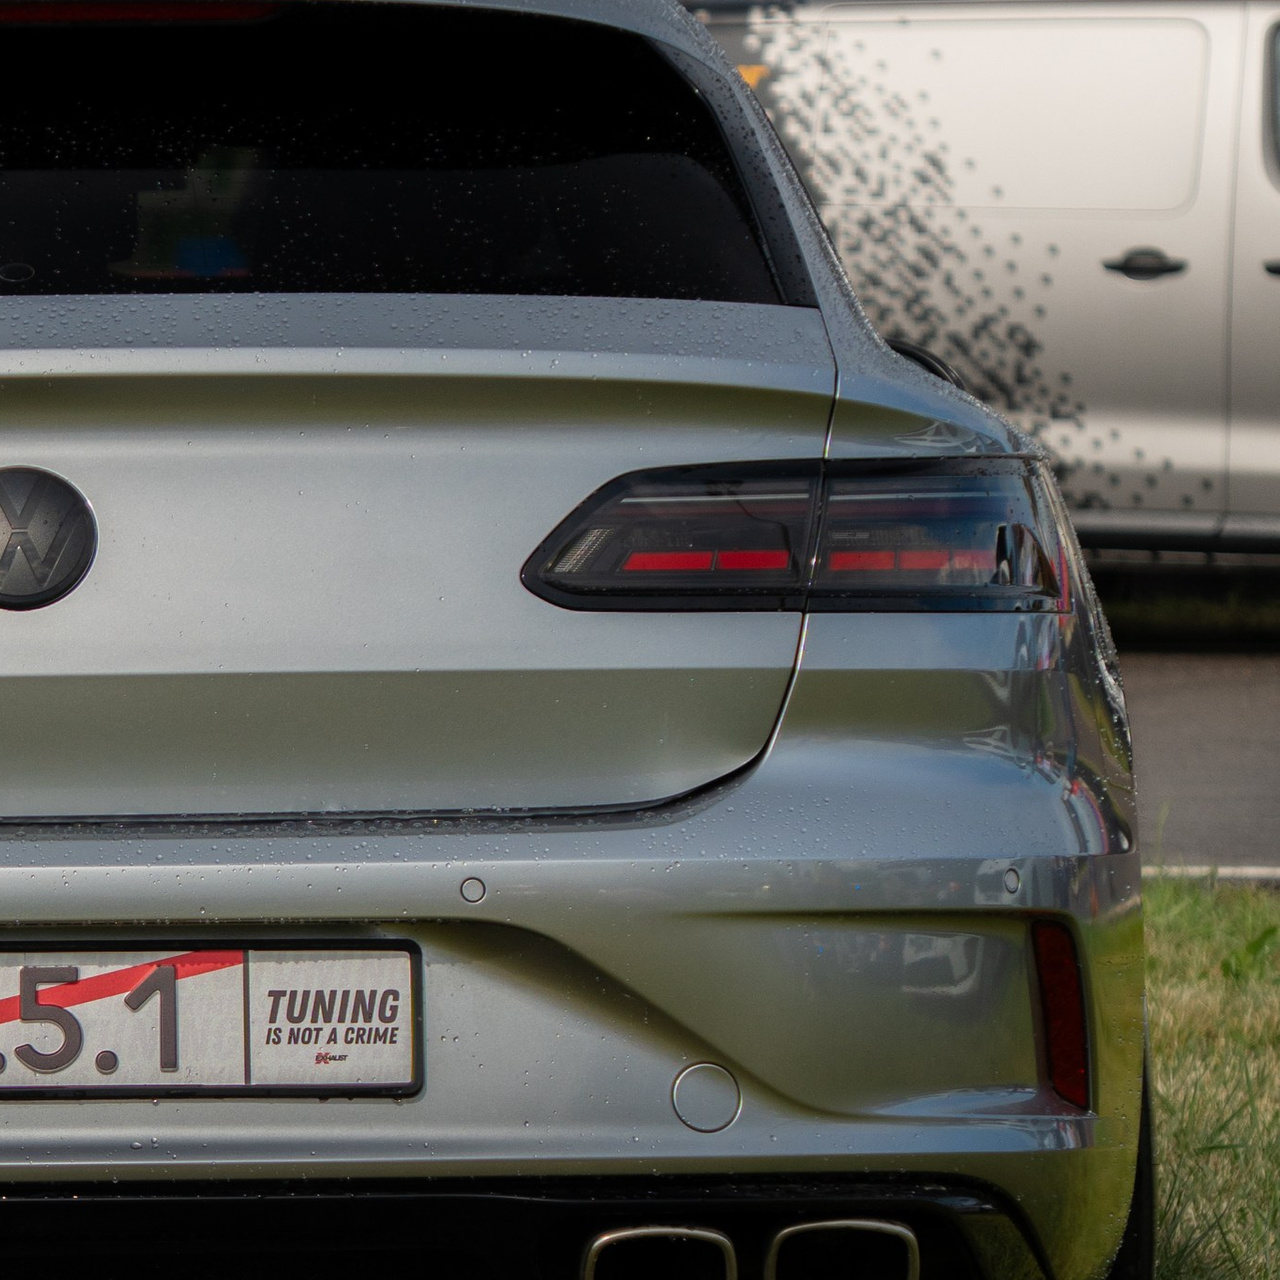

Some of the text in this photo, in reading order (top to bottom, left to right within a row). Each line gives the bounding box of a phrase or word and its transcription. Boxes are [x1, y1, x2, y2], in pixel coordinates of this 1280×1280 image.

[267, 989, 400, 1024] TUNING
[265, 1026, 400, 1045] IS NOT A CRIME
